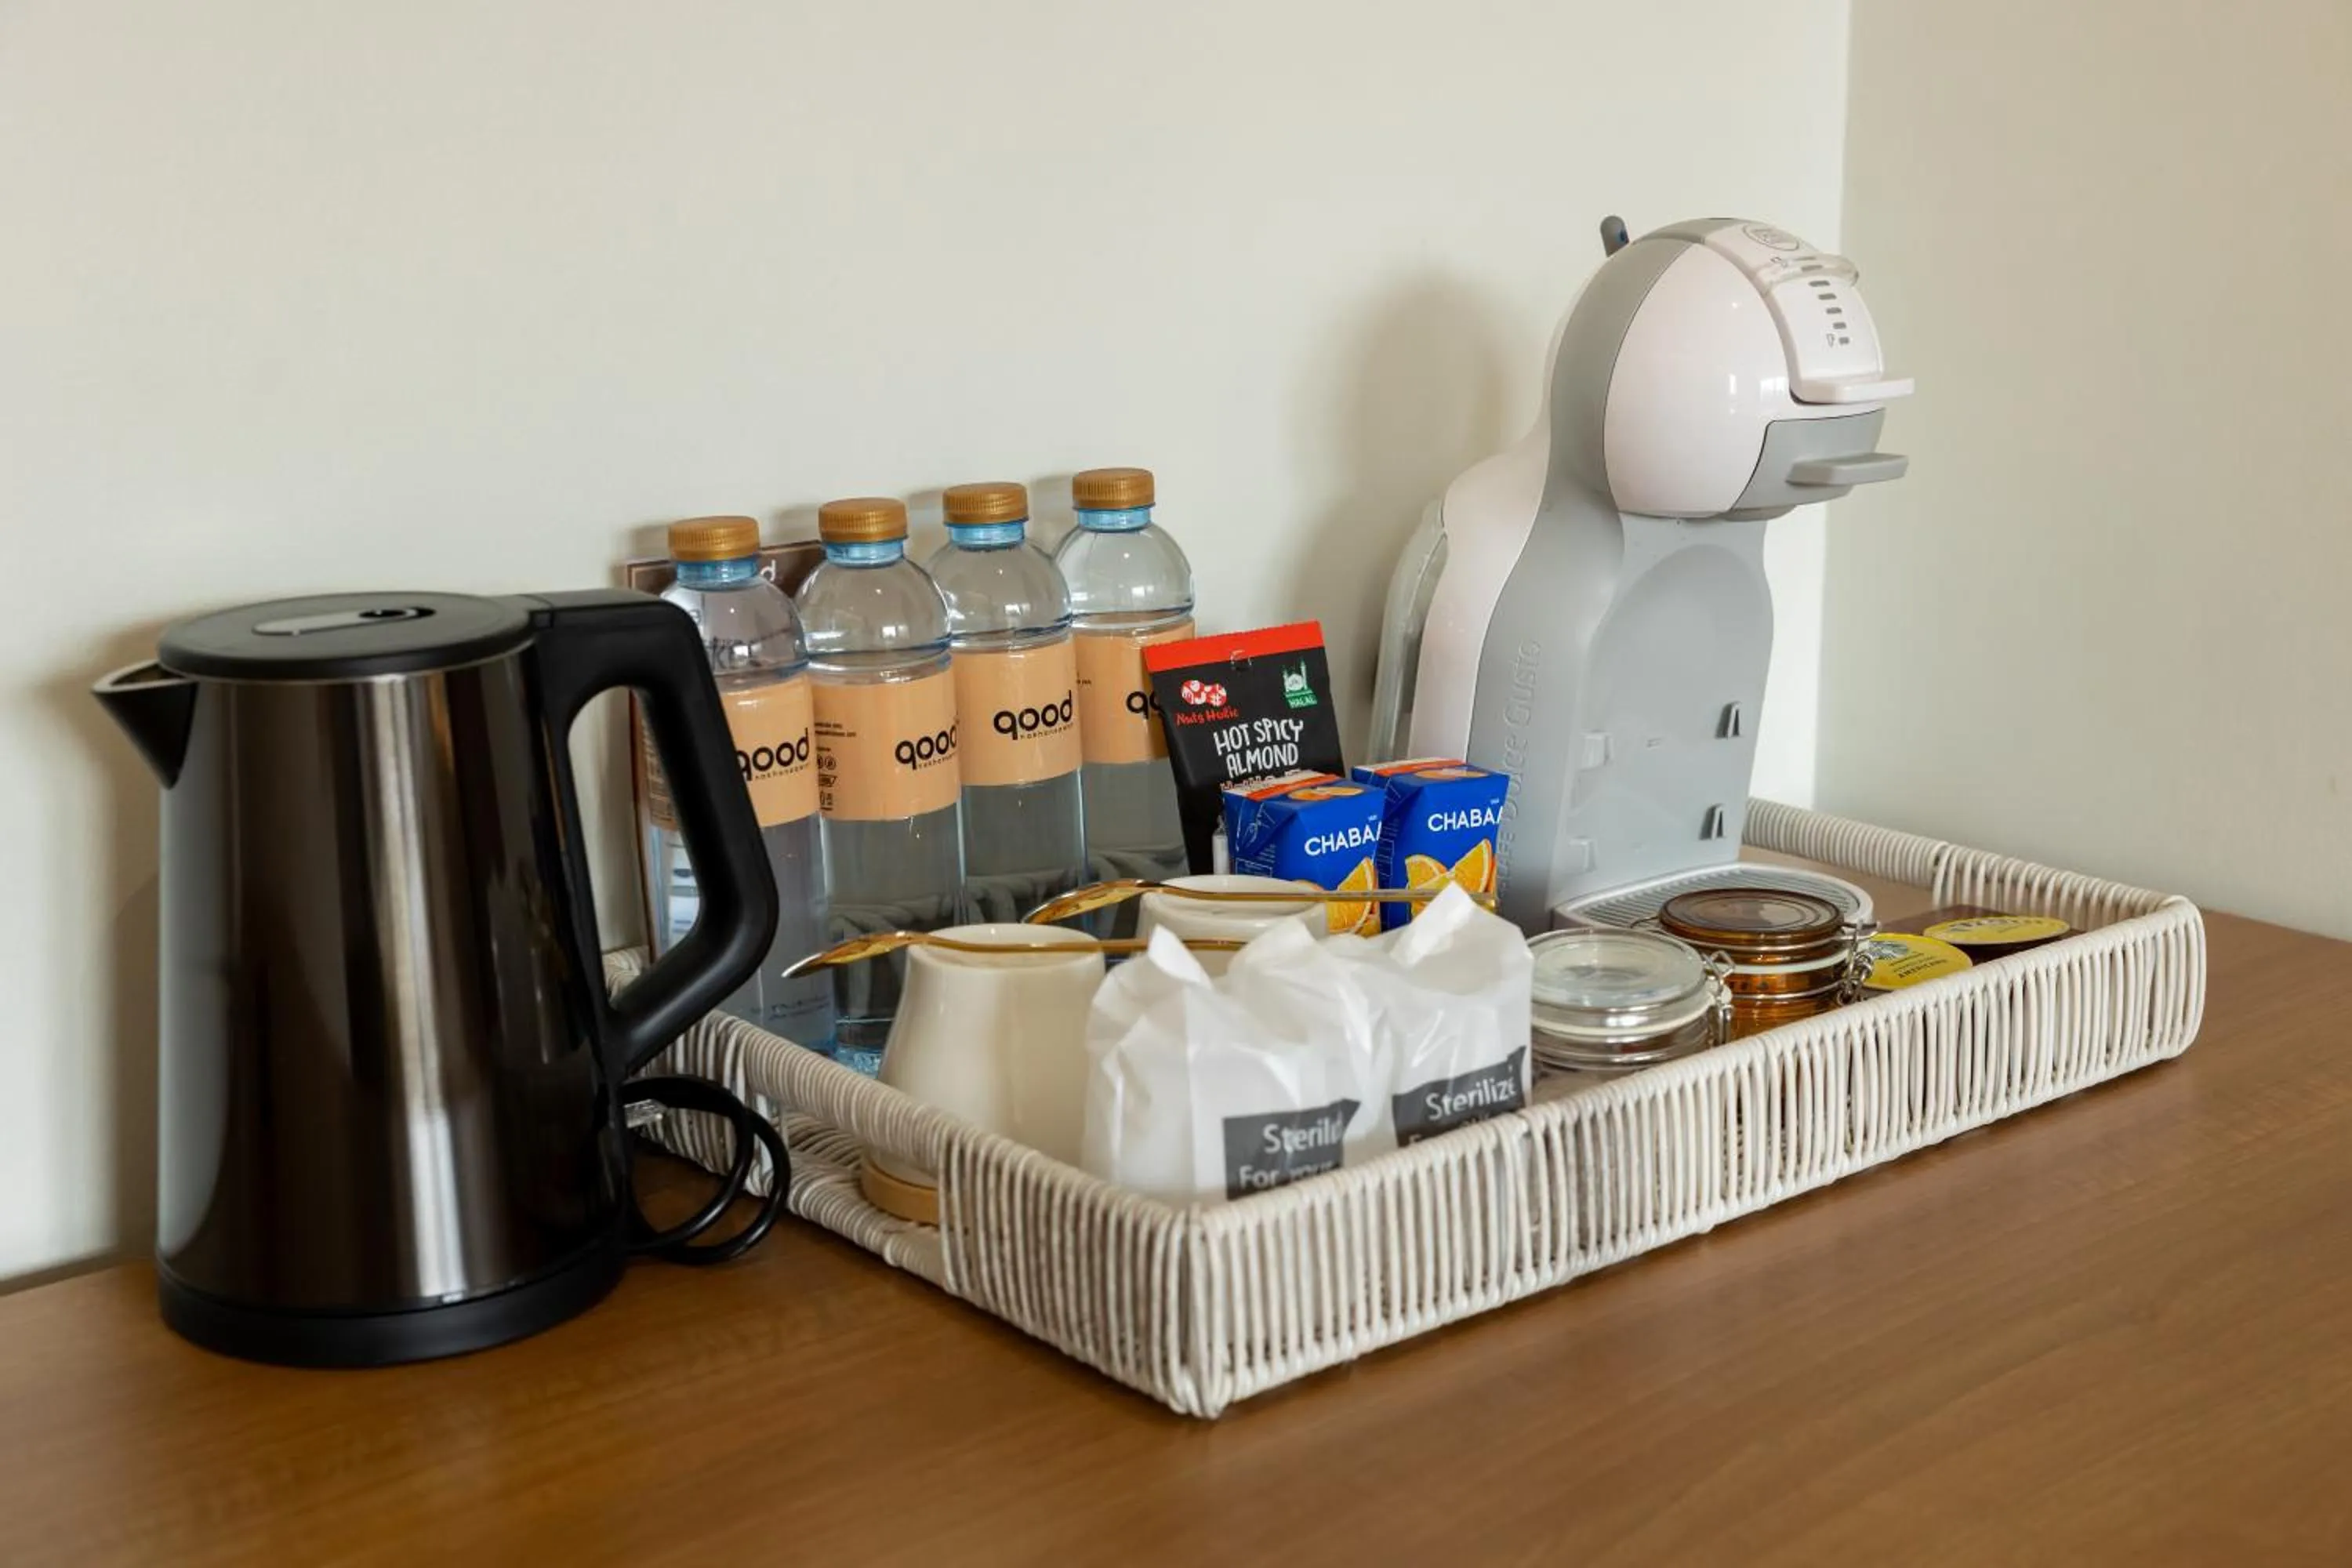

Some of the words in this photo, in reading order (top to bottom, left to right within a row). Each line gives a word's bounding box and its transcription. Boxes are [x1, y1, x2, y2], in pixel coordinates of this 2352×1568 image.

[993, 689, 1073, 740] qood
[1213, 723, 1250, 756] HOT
[1253, 717, 1304, 744] SPICY
[1225, 742, 1299, 779] ALMOND
[1239, 1163, 1279, 1189] For
